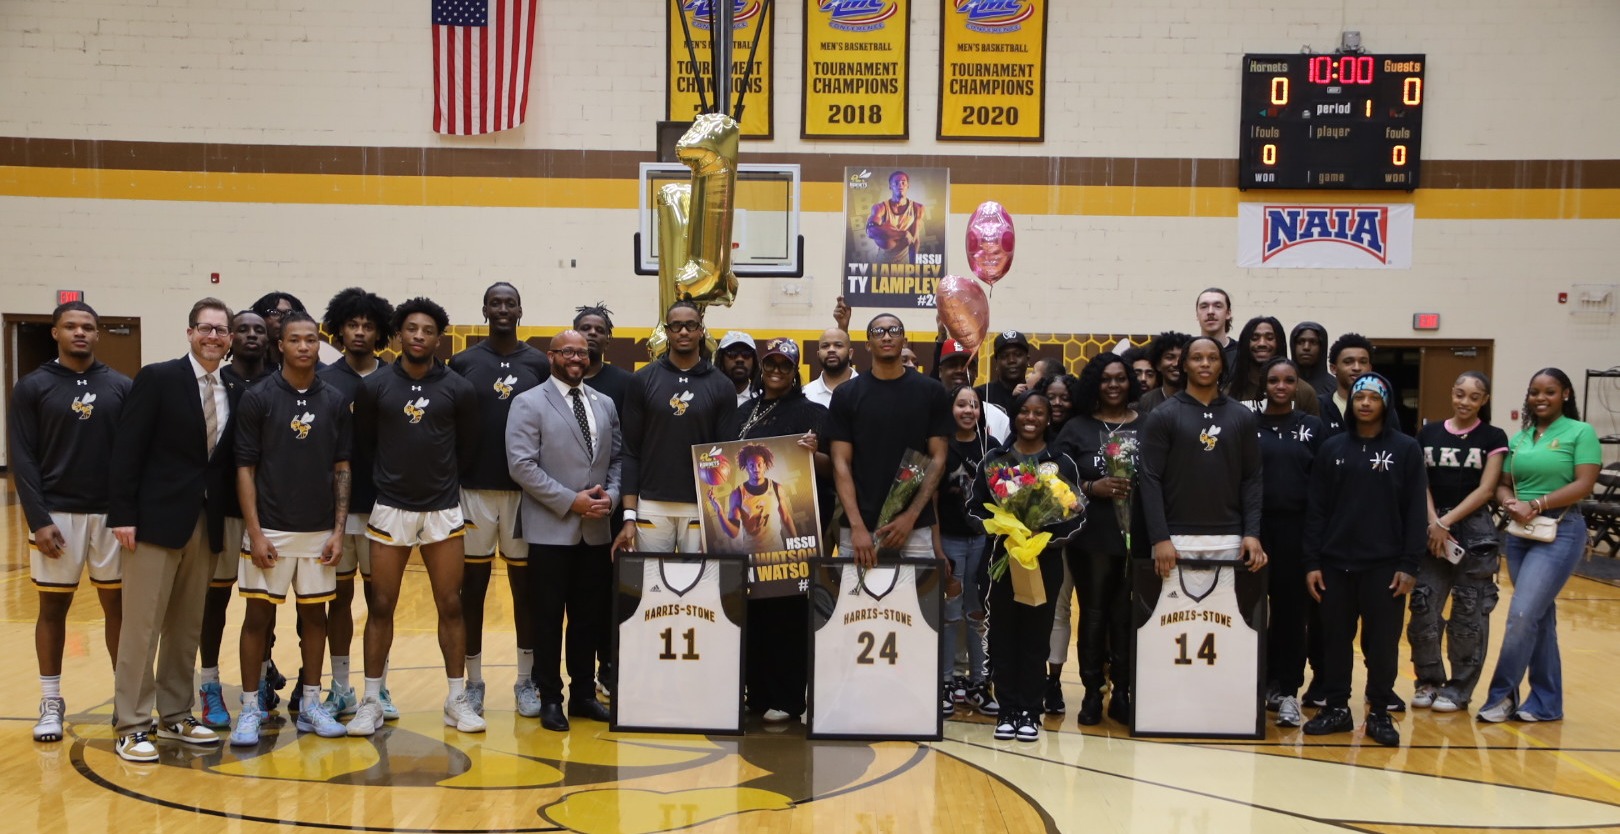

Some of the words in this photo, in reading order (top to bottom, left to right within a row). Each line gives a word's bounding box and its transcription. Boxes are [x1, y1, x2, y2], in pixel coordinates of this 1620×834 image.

[820, 42, 843, 51] MEN'S
[844, 42, 892, 51] BASKETBALL
[957, 43, 980, 52] MEN'S
[981, 44, 1028, 53] BASKETBALL
[813, 62, 898, 76] TOURNAMENT
[951, 63, 1034, 77] TOURNAMENT
[1250, 60, 1288, 72] Hornets
[1309, 56, 1373, 84] 10:00
[1384, 60, 1421, 73] Guests
[813, 78, 898, 94] CHAMPIONS
[950, 79, 1034, 96] CHAMPIONS
[1271, 77, 1288, 105] 0
[1403, 77, 1421, 105] 0
[828, 104, 882, 124] 2018
[961, 106, 1019, 125] 2020
[1317, 102, 1351, 115] period
[1366, 99, 1372, 118] 1
[1255, 126, 1280, 138] fouls
[1317, 125, 1351, 139] player
[1386, 127, 1411, 139] fouls
[1263, 144, 1277, 165] 0
[1392, 145, 1406, 166] 0
[1255, 173, 1275, 182] won
[1319, 172, 1345, 184] game
[1385, 173, 1405, 183] won
[1267, 211, 1383, 254] NAIA
[916, 254, 942, 265] HSSU
[848, 276, 868, 294] TY
[786, 536, 816, 550] HSSU
[659, 627, 700, 660] 11
[857, 631, 898, 665] 24
[1175, 632, 1217, 666] 14
